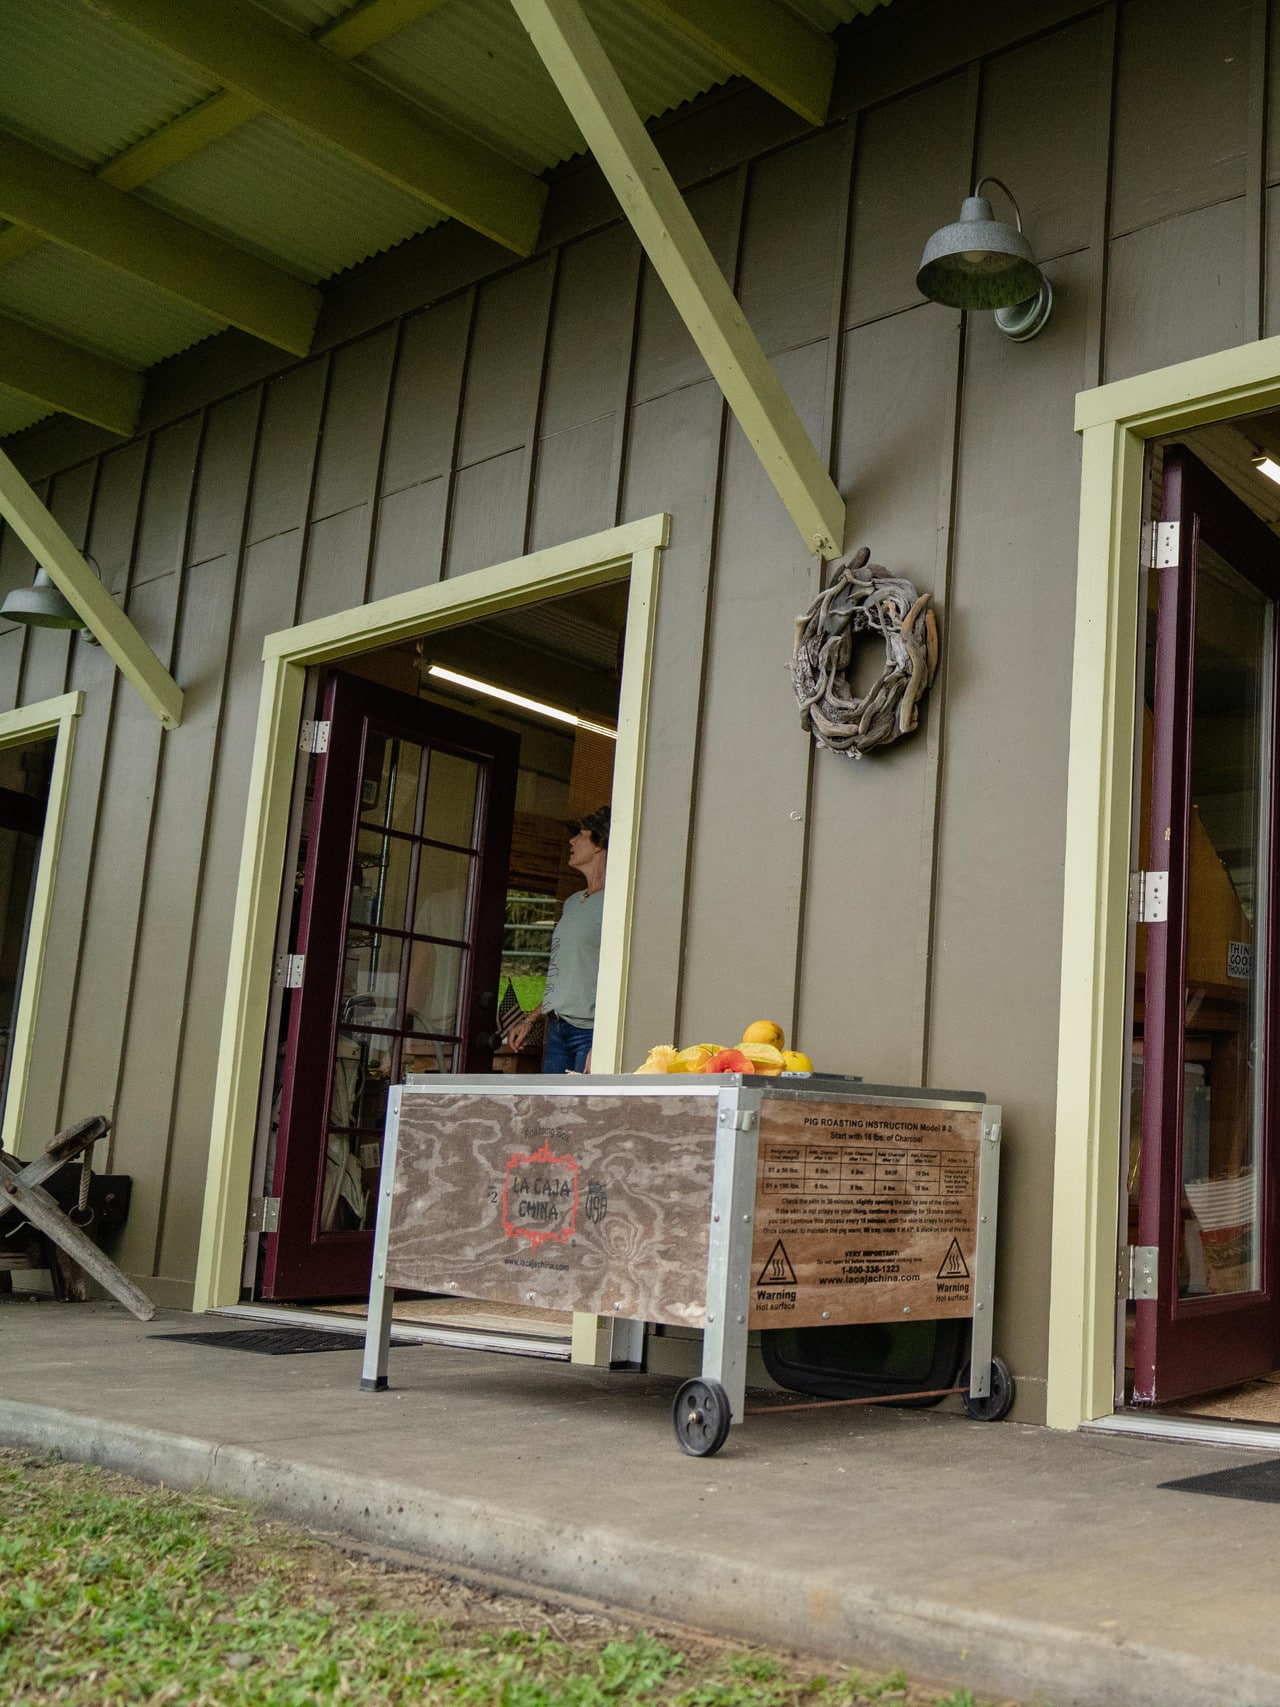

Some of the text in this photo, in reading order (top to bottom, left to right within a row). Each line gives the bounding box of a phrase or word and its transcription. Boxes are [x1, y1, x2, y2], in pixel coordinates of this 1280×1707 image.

[804, 1118, 818, 1126] PIG
[820, 1118, 864, 1128] ROASTING
[866, 1121, 918, 1131] INSTRUCTION
[920, 1124, 940, 1132] Model
[524, 1126, 570, 1142] Roasting Box
[830, 1131, 847, 1140] Start
[848, 1132, 862, 1140] with
[894, 1134, 923, 1142] Charcoal
[512, 1177, 530, 1194] LA
[534, 1178, 571, 1198] CAJA
[518, 1200, 559, 1220] CHINA
[504, 1258, 570, 1272] www.lacajachina.com
[819, 1273, 920, 1284] www.lacajachina.com
[936, 1283, 970, 1293] Warning
[757, 1290, 796, 1302] Warning
[756, 1302, 796, 1311] Hot surface
